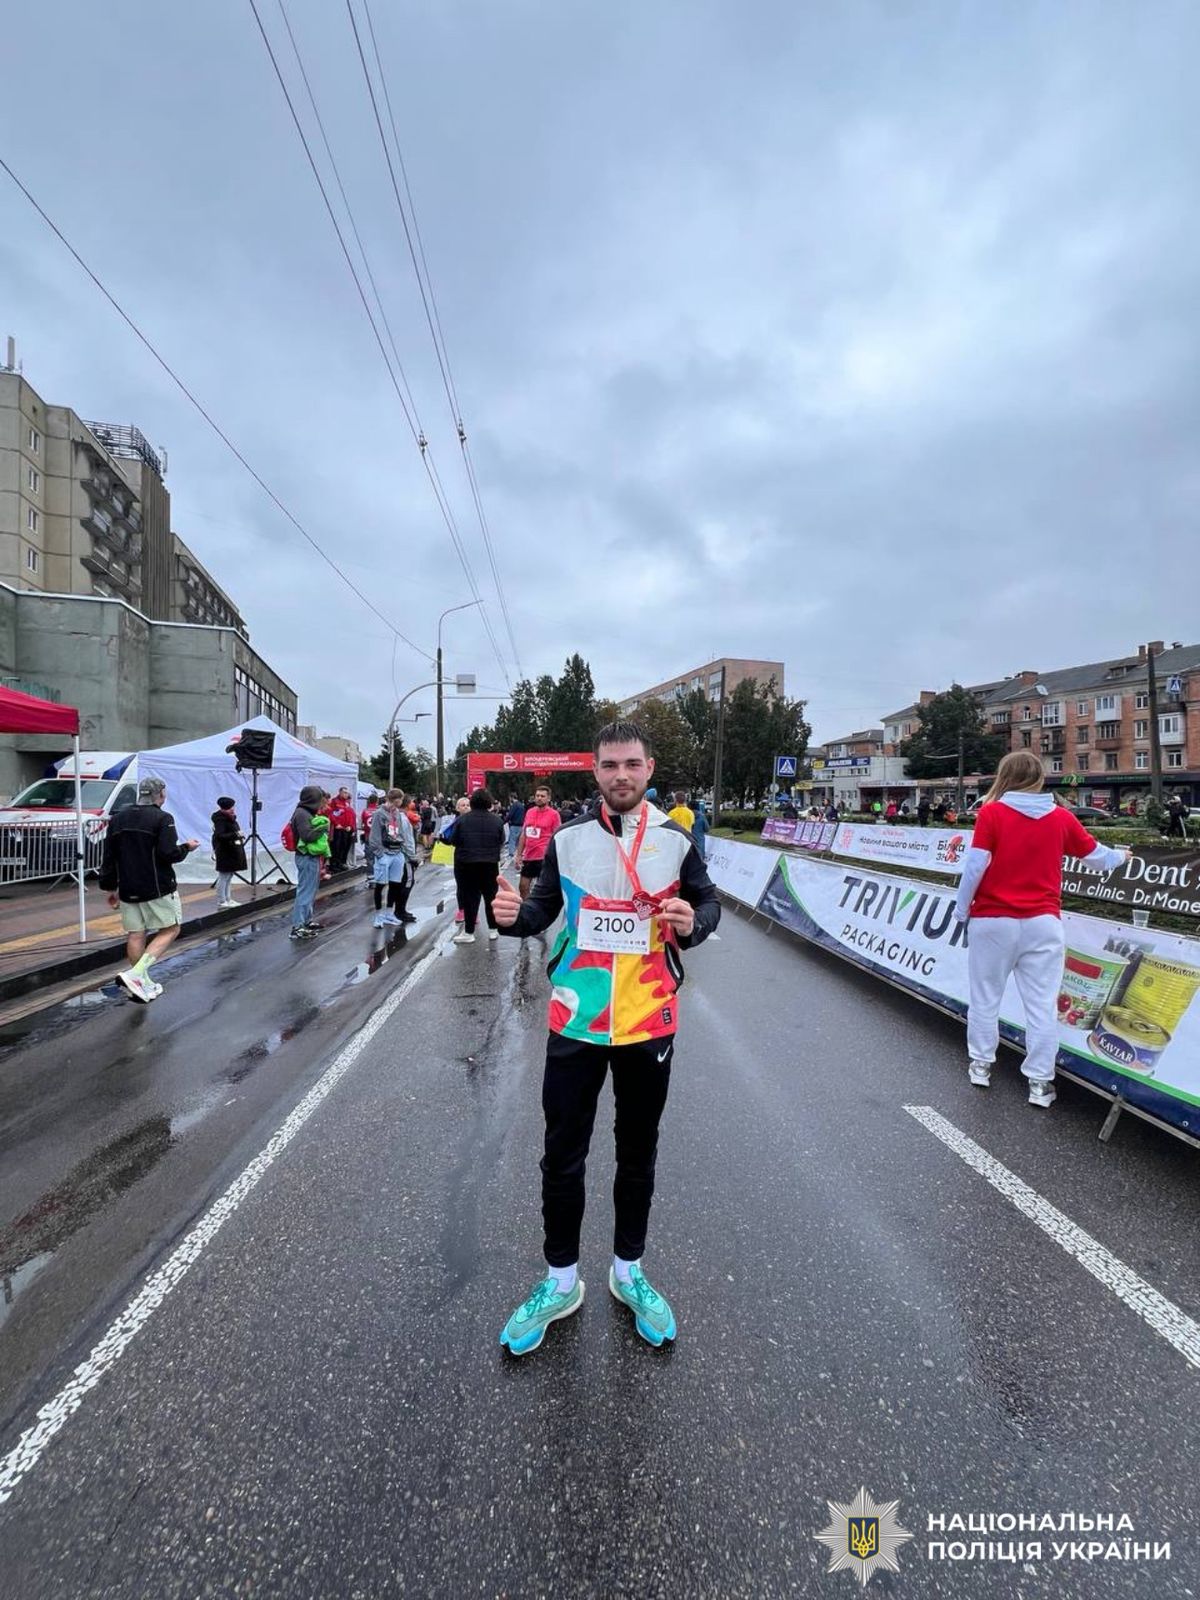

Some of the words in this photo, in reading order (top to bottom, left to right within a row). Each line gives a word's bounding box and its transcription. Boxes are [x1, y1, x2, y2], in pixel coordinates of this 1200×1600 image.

[1122, 856, 1192, 887] Dent
[1086, 883, 1126, 900] clinic
[593, 916, 635, 934] 2100
[840, 924, 936, 976] PACKAGING
[1099, 1036, 1134, 1062] KAVIAR
